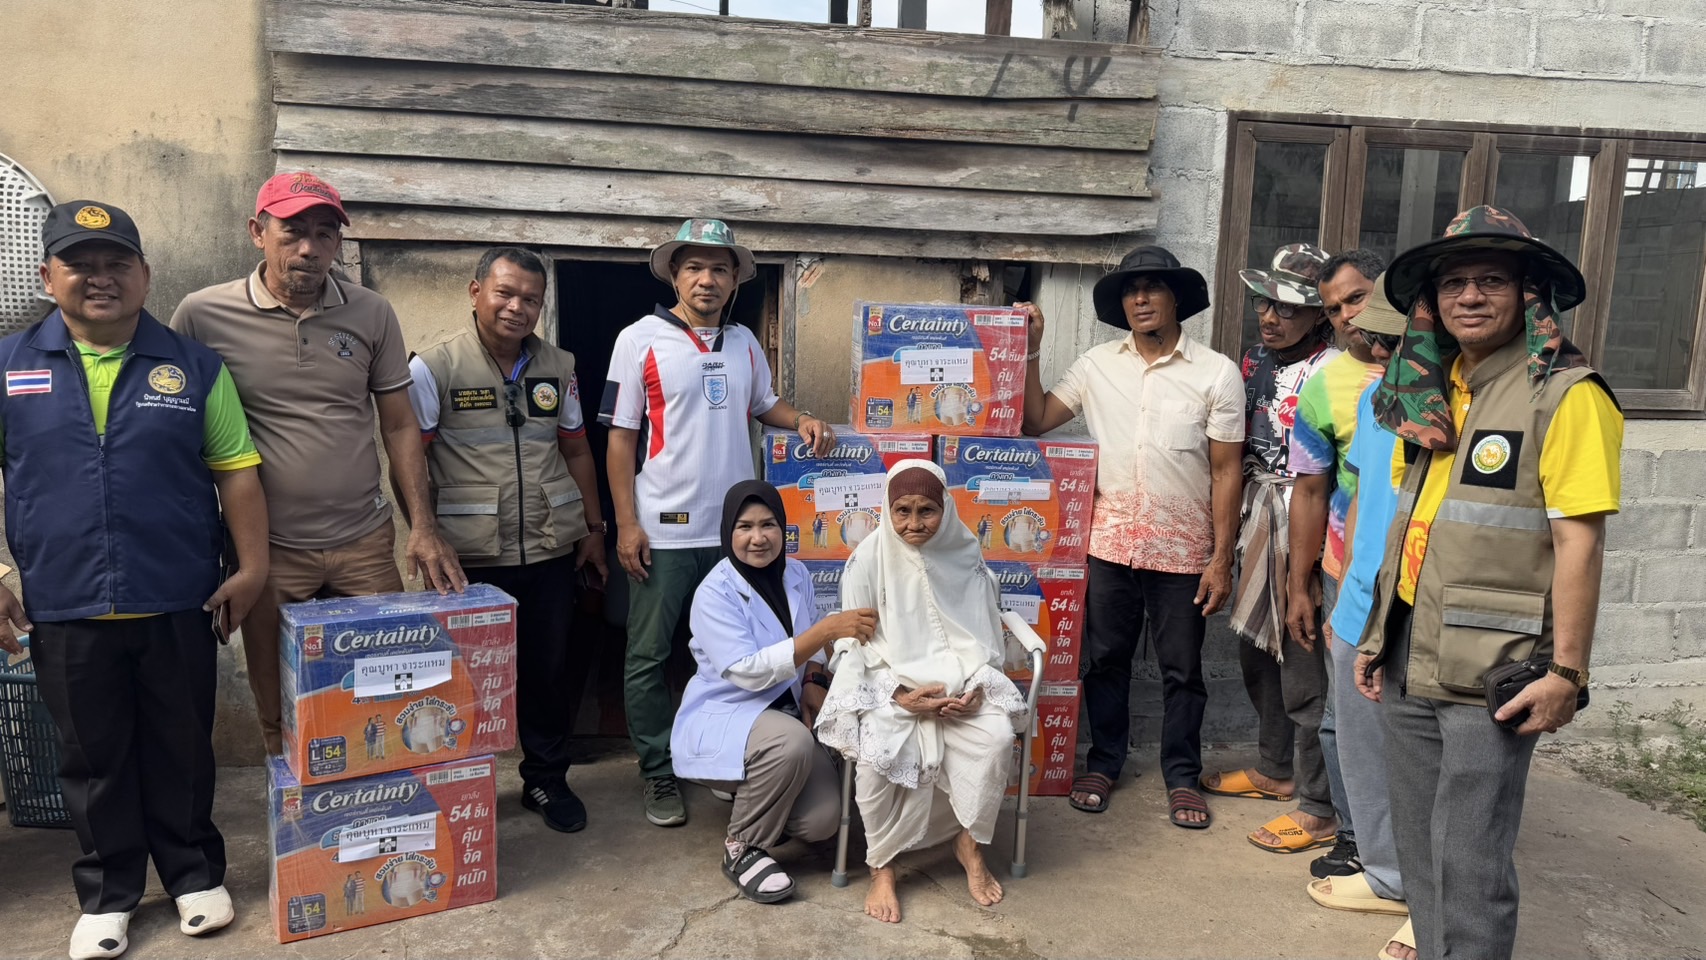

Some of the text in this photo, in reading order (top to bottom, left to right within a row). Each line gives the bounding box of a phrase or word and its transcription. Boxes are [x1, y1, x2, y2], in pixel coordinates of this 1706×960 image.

[889, 315, 968, 336] Certainty
[989, 347, 1007, 361] 54
[878, 405, 889, 415] 54
[991, 405, 1015, 418] หนัก
[794, 444, 873, 464] Ceainty
[965, 445, 1040, 467] Certainty
[1059, 479, 1076, 492] 54
[1077, 480, 1090, 493] ชิ้น
[1058, 534, 1082, 547] หนัก
[1050, 598, 1080, 612] 54 ชิ้น
[305, 638, 322, 650] No.1
[334, 625, 440, 652] Certainty
[470, 652, 491, 668] 54
[1050, 652, 1073, 664] หนัก
[396, 701, 424, 724] สวมง่าย
[476, 716, 507, 734] หนัก
[1044, 715, 1074, 728] 54 ชิ้น
[312, 745, 341, 760] L 54
[1044, 767, 1067, 779] หนัก
[313, 782, 418, 812] Certainty
[449, 803, 489, 822] 54 ชิ้น
[462, 828, 483, 849] คุ้ม
[463, 849, 482, 865] จัด
[375, 856, 404, 881] สวมง่าย
[456, 869, 487, 887] หนัก
[291, 902, 320, 918] L 54
